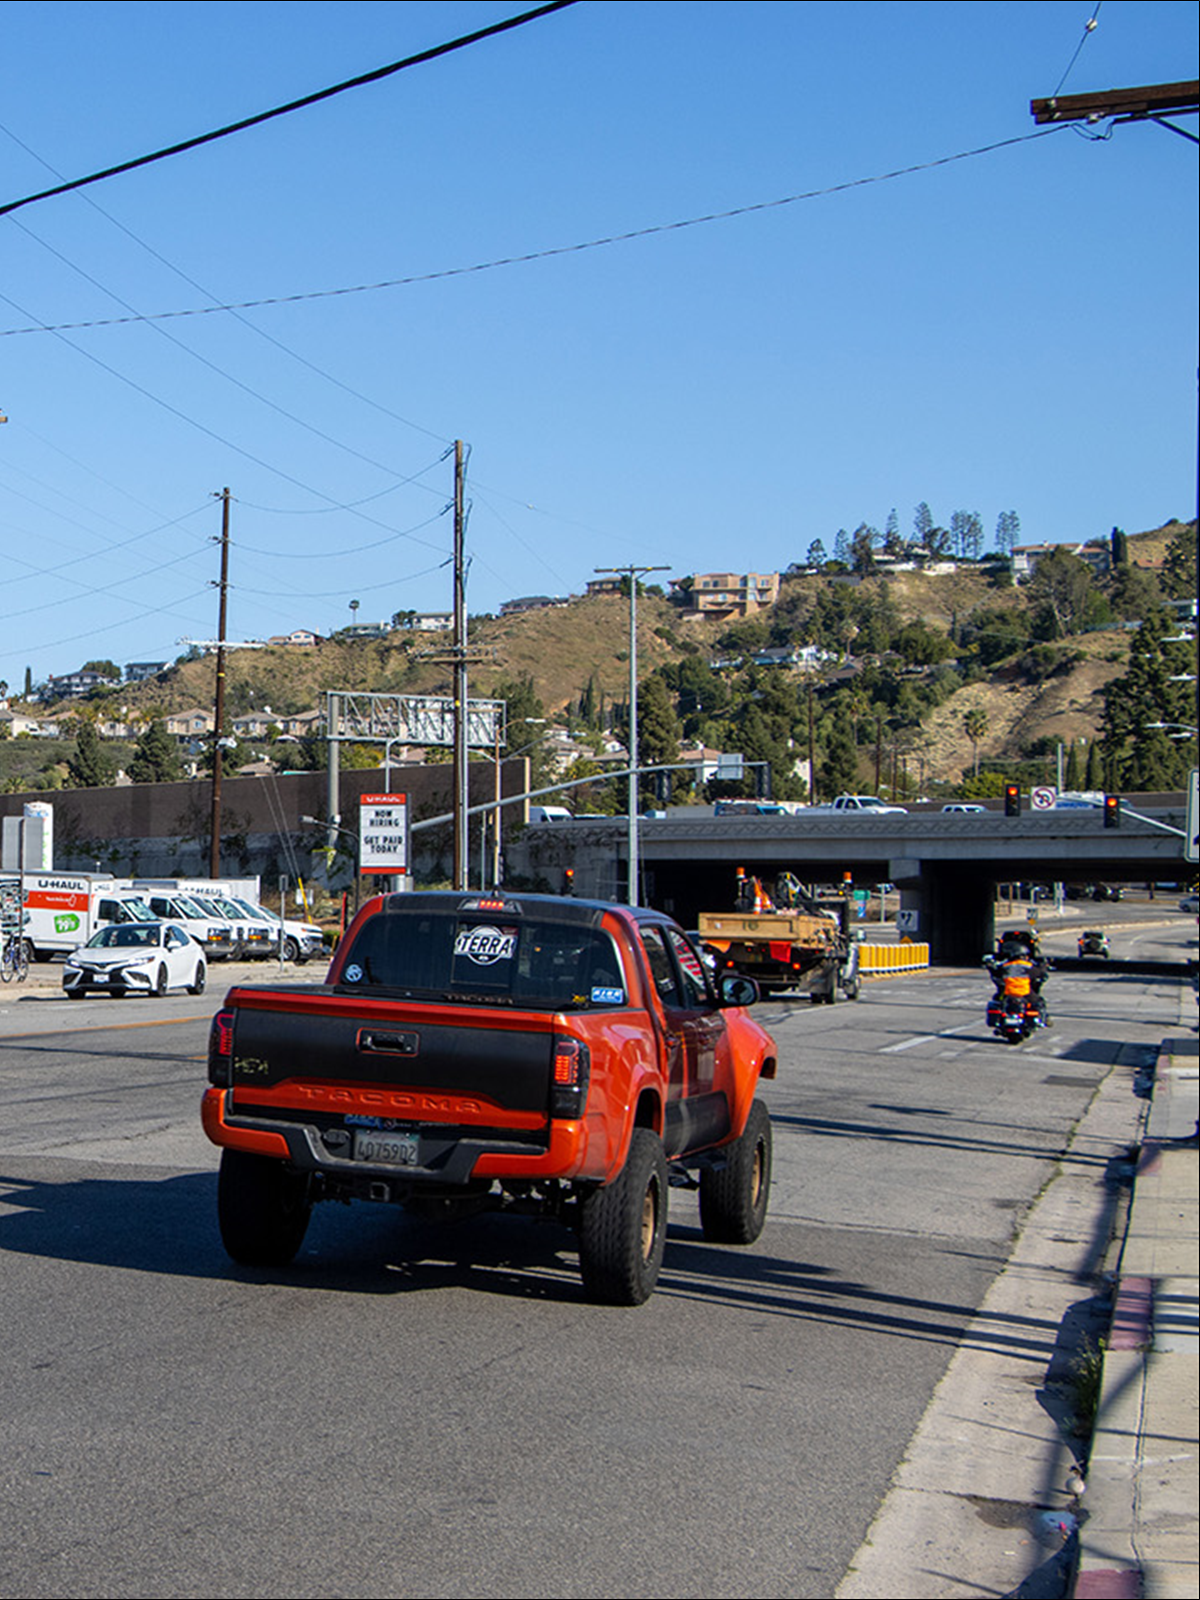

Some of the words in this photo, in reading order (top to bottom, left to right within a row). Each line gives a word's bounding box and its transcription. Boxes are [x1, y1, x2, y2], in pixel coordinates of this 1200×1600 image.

[375, 809, 392, 817] NOW
[369, 818, 399, 827] HIRING
[364, 835, 379, 845] GET
[382, 835, 403, 845] PAID
[371, 845, 398, 854] TODAY
[38, 879, 84, 890] U-HAUL
[461, 934, 512, 955] TERRA
[299, 1085, 482, 1114] TACOMA
